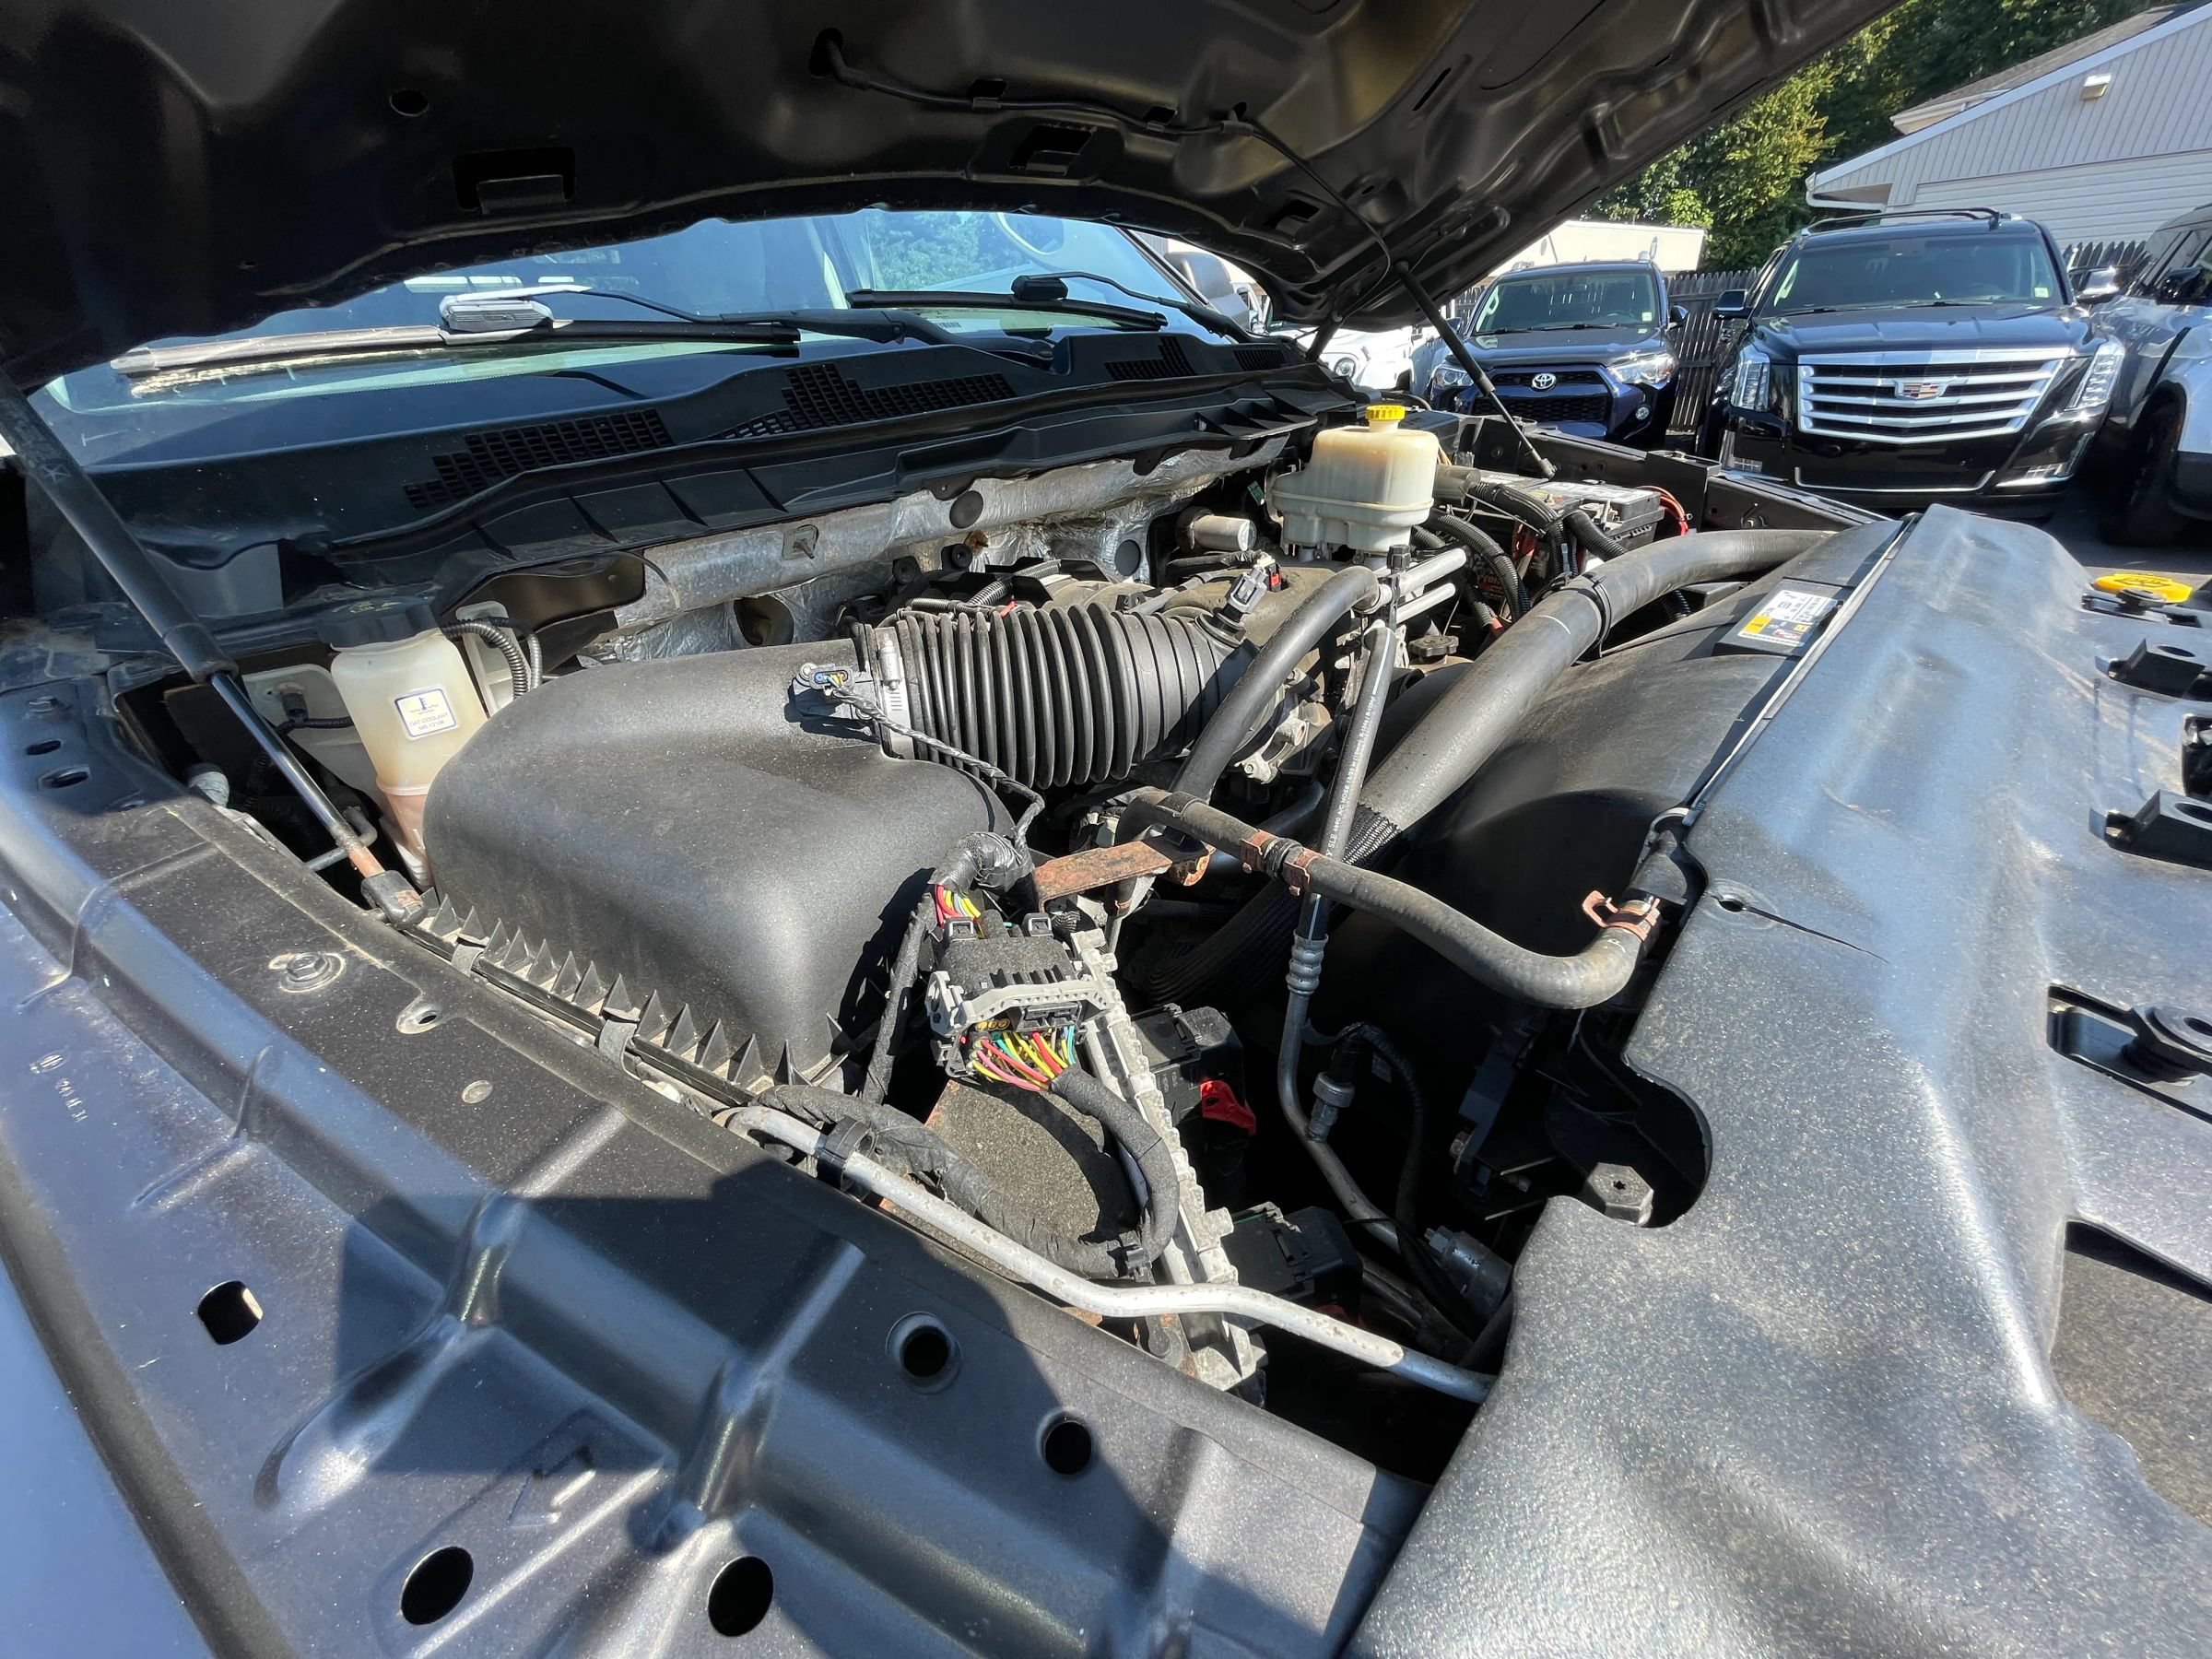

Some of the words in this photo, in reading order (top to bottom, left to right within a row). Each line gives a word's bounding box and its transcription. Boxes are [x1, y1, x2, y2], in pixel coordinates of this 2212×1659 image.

[421, 712, 448, 723] COOLANT
[1328, 833, 1337, 848] SLE
[1341, 784, 1350, 804] HOSE
